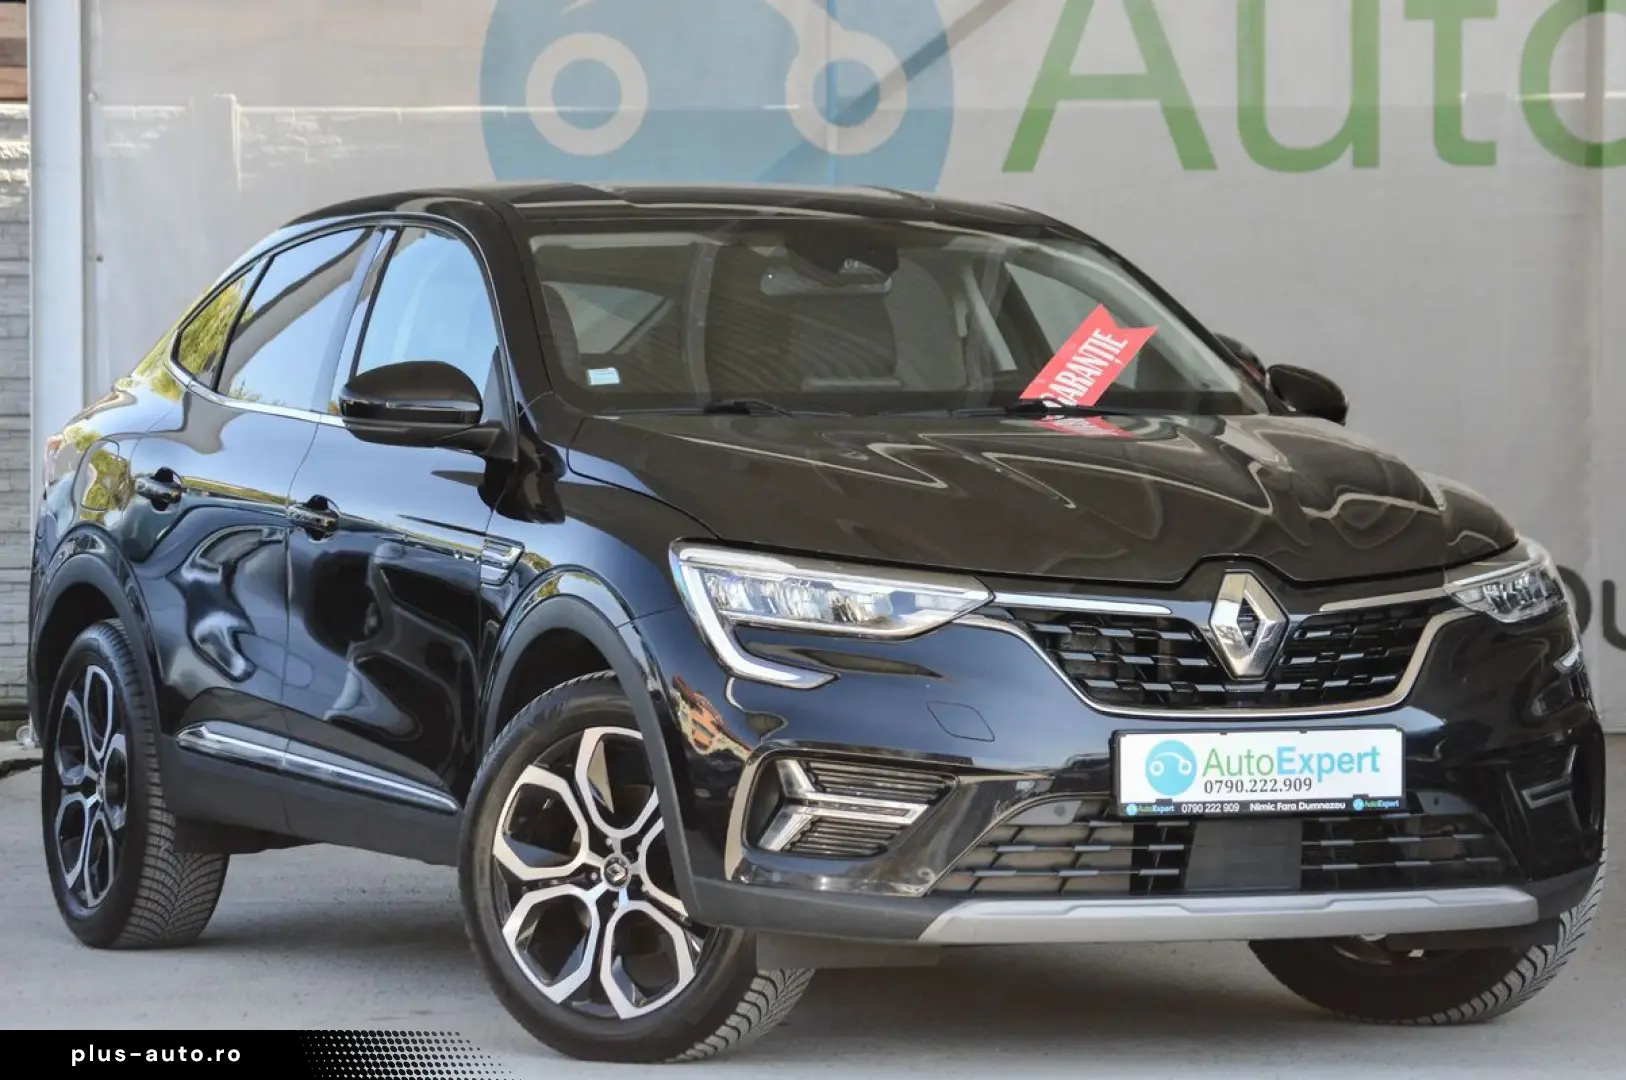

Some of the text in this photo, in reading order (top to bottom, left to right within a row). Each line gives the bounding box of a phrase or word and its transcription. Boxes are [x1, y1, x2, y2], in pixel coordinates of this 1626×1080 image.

[1202, 746, 1380, 782] AutoExpert
[1203, 777, 1312, 794] 0790.222.909
[1181, 803, 1203, 813] 0790
[1205, 803, 1221, 813] 222
[1222, 802, 1240, 812] 909
[1250, 802, 1274, 811] Nimic
[1277, 802, 1297, 811] Fara
[1299, 801, 1346, 810] Dumnezeu
